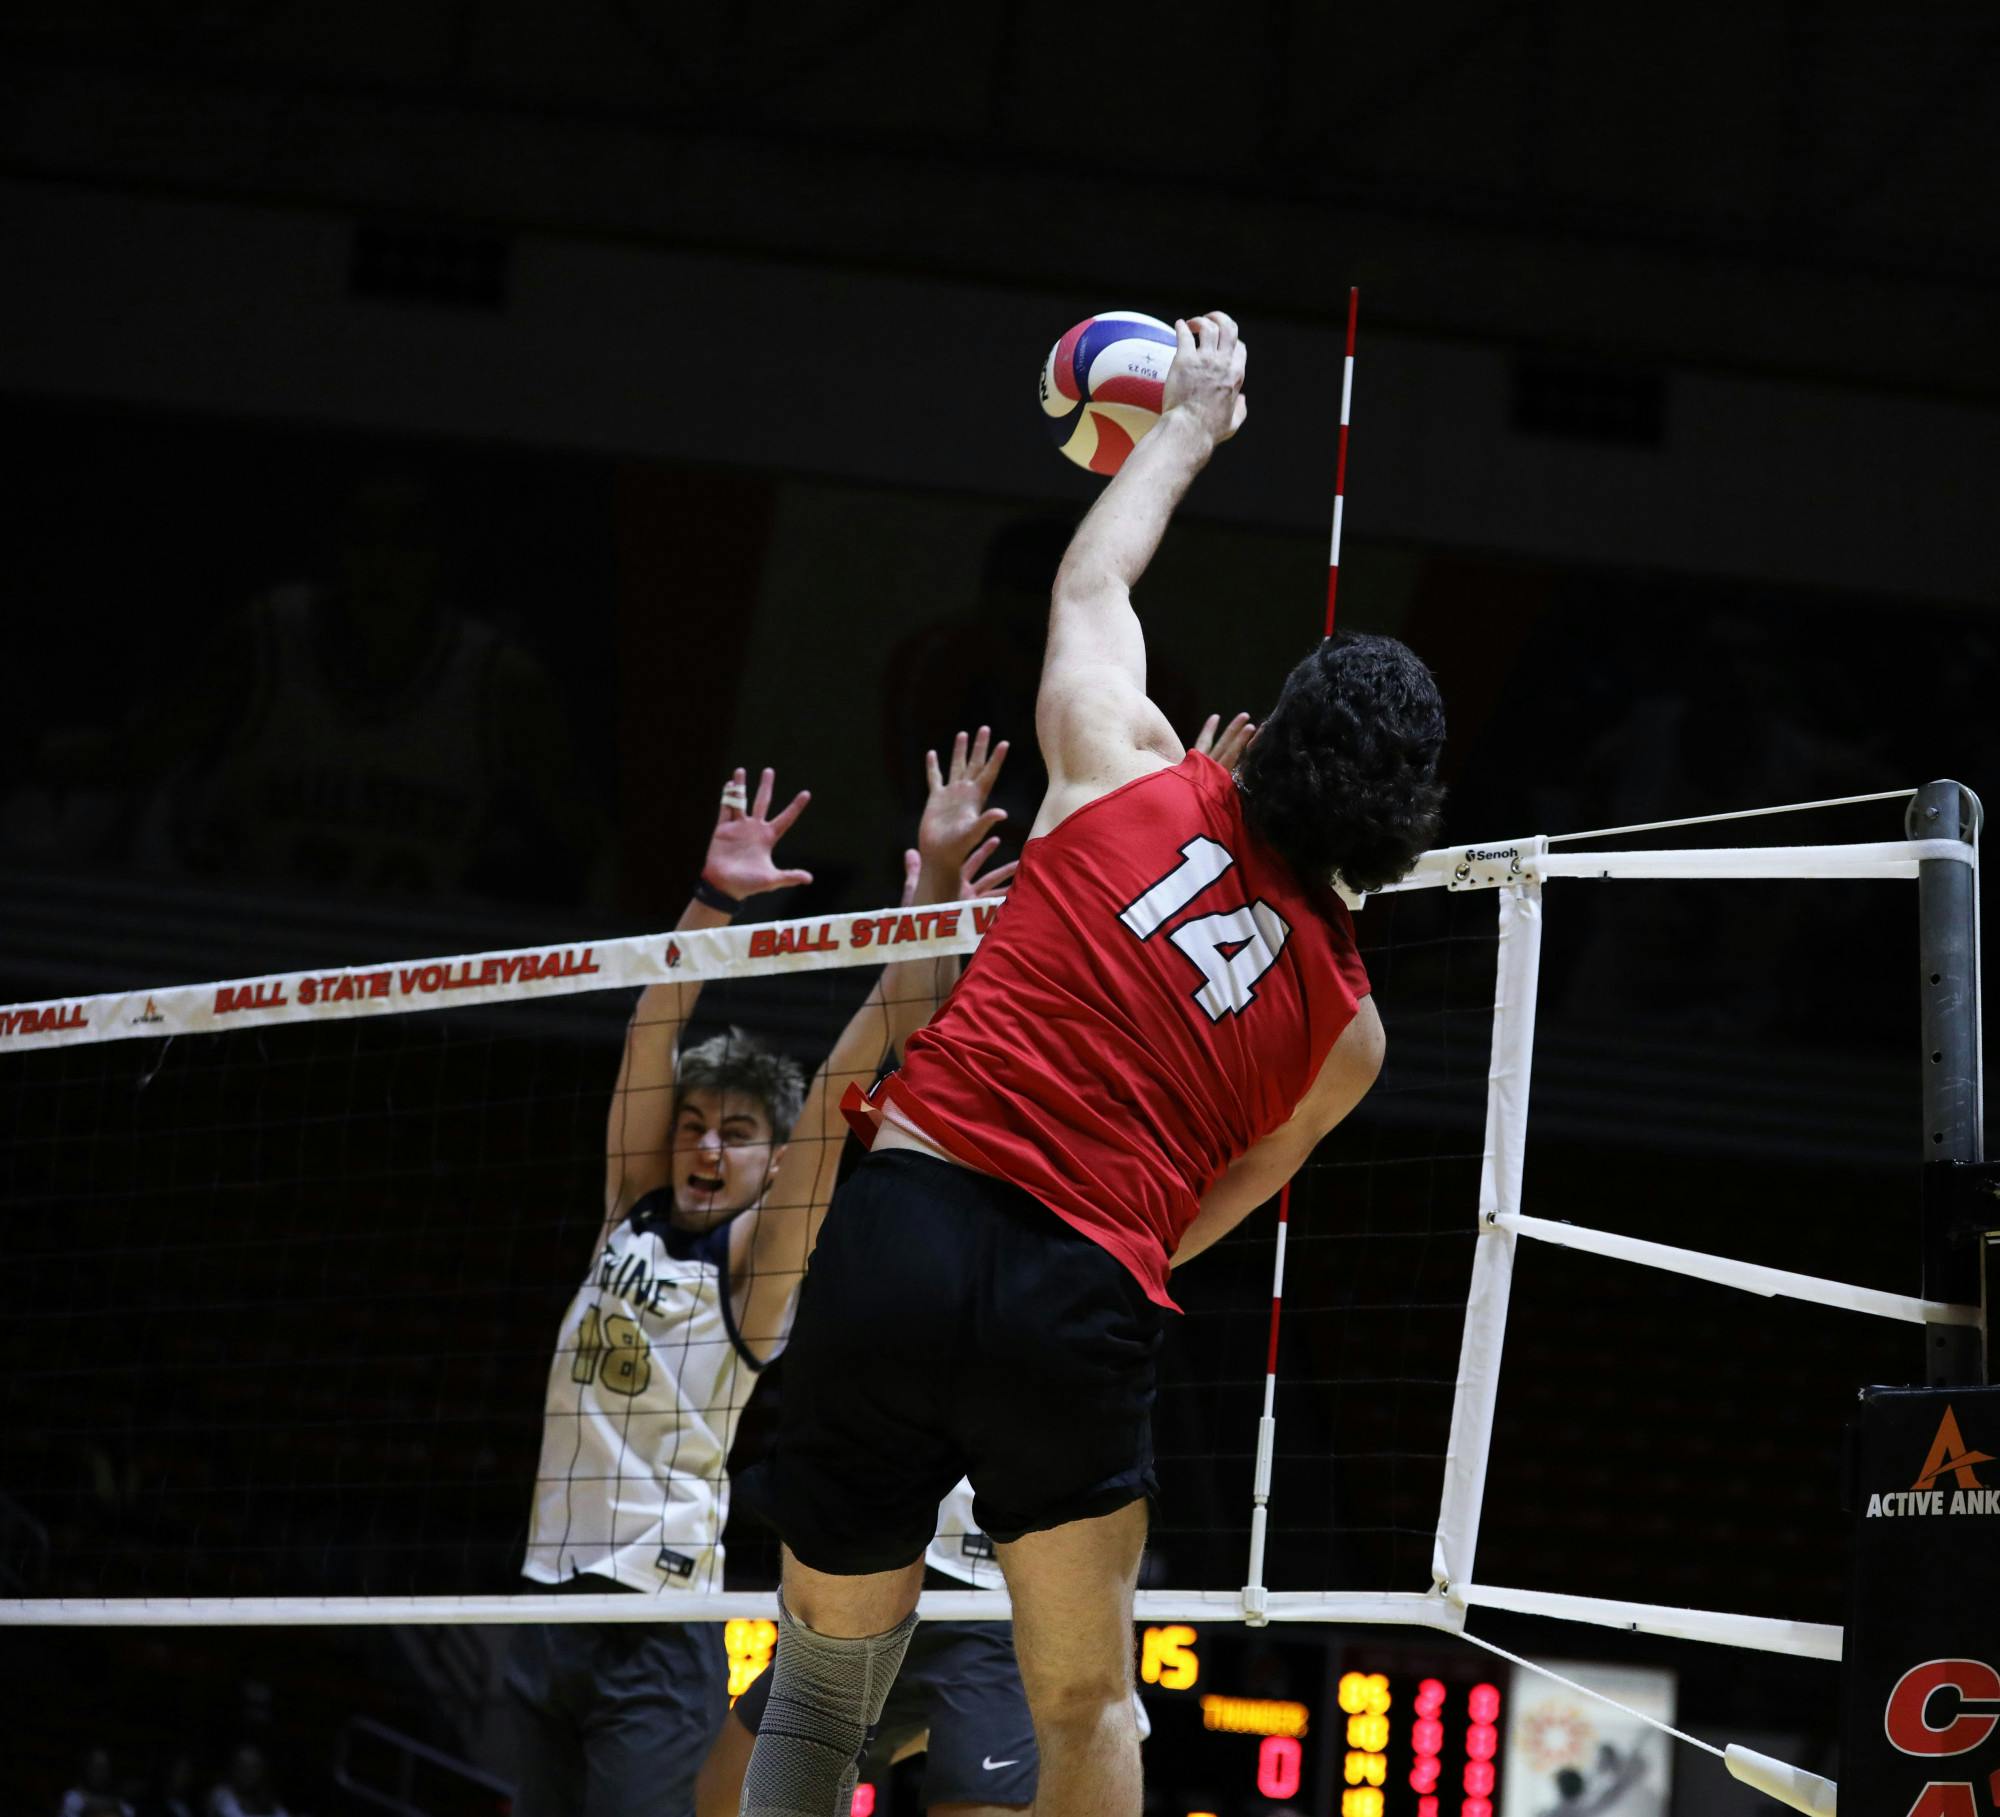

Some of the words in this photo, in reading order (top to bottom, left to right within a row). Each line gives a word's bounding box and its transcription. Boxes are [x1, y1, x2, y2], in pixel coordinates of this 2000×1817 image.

[1477, 848, 1518, 861] Senoh
[749, 923, 839, 958] BALL
[851, 909, 961, 949] STATE
[1117, 834, 1293, 1025] 14
[213, 981, 288, 1015] BALL
[298, 971, 393, 1006] STATE
[400, 948, 599, 996] VOLLEYBALL
[572, 1303, 652, 1397] 18
[1866, 1491, 1944, 1518] ACTIVE
[1141, 1625, 1199, 1691] 15
[1884, 1658, 2000, 1758] C
[1257, 1734, 1303, 1800] 0
